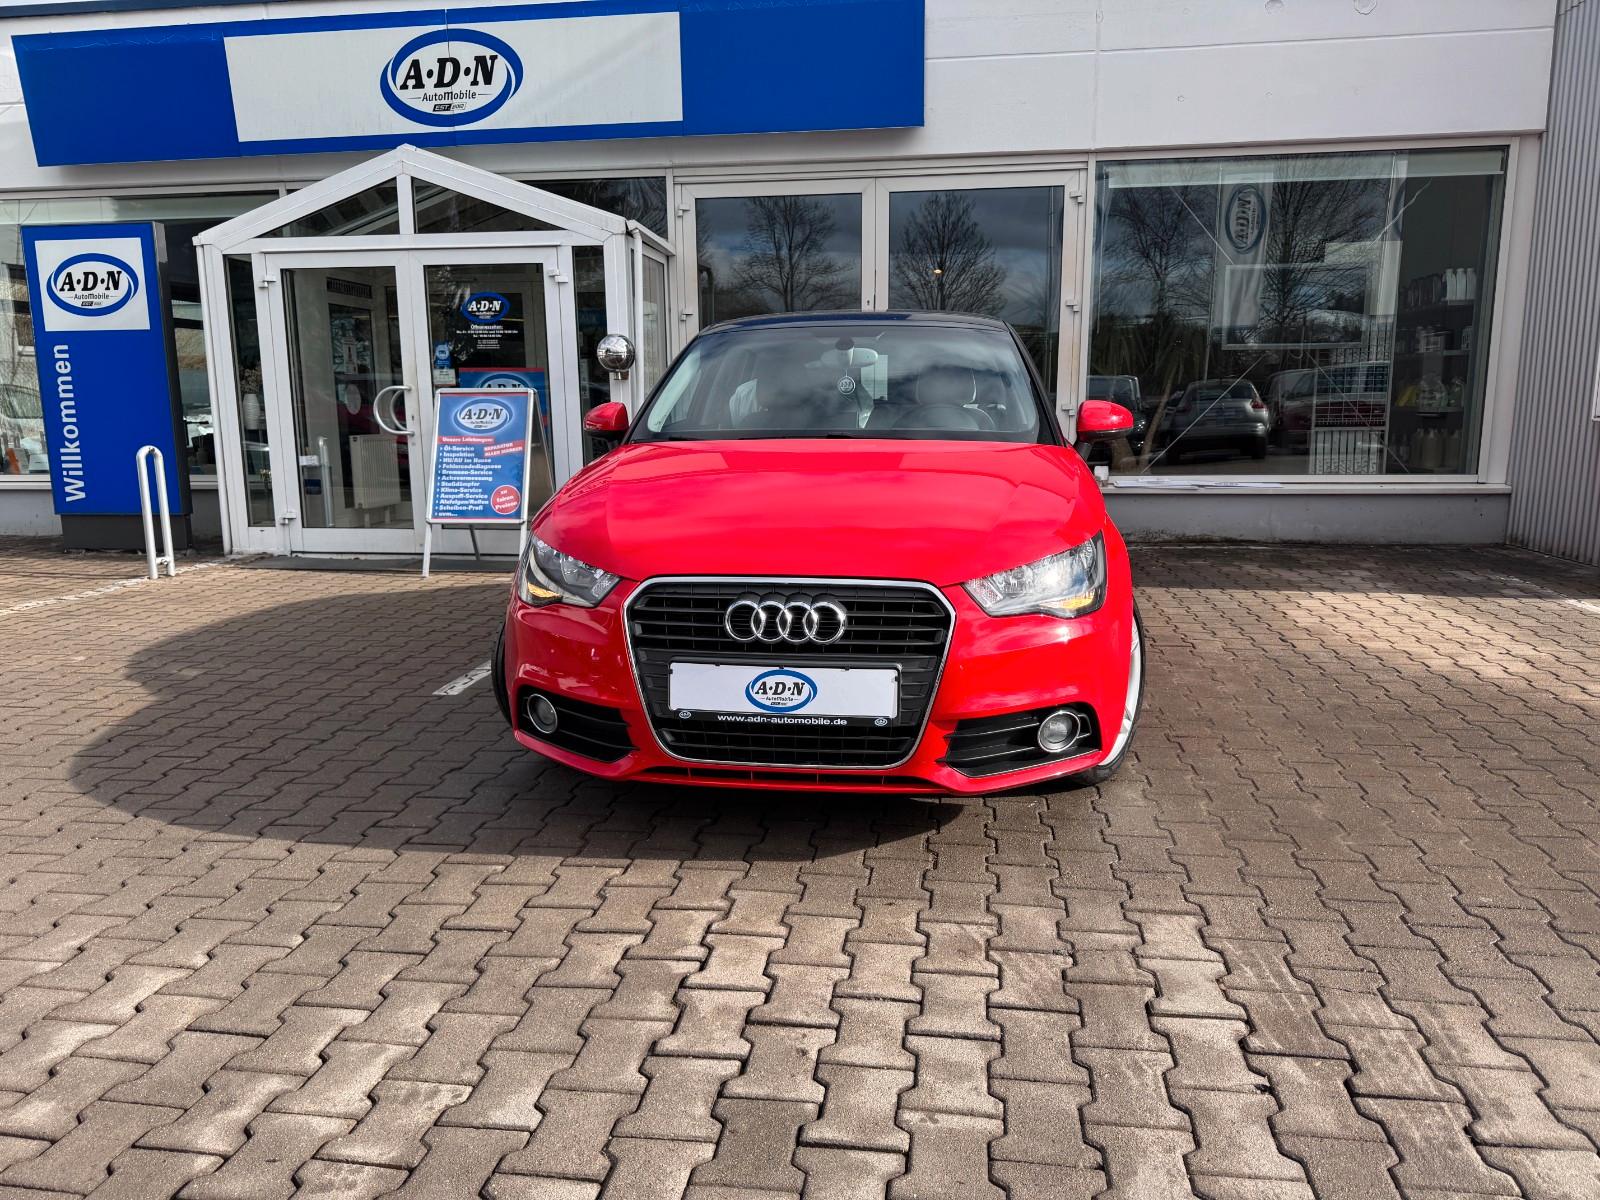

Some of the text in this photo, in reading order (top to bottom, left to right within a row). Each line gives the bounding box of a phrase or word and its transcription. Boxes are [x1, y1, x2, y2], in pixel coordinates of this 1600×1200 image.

[422, 90, 476, 102] AutoMobile
[73, 292, 110, 300] AutoMobile
[54, 344, 86, 502] Willkommen
[718, 714, 848, 726] www.adn-automobile.de
